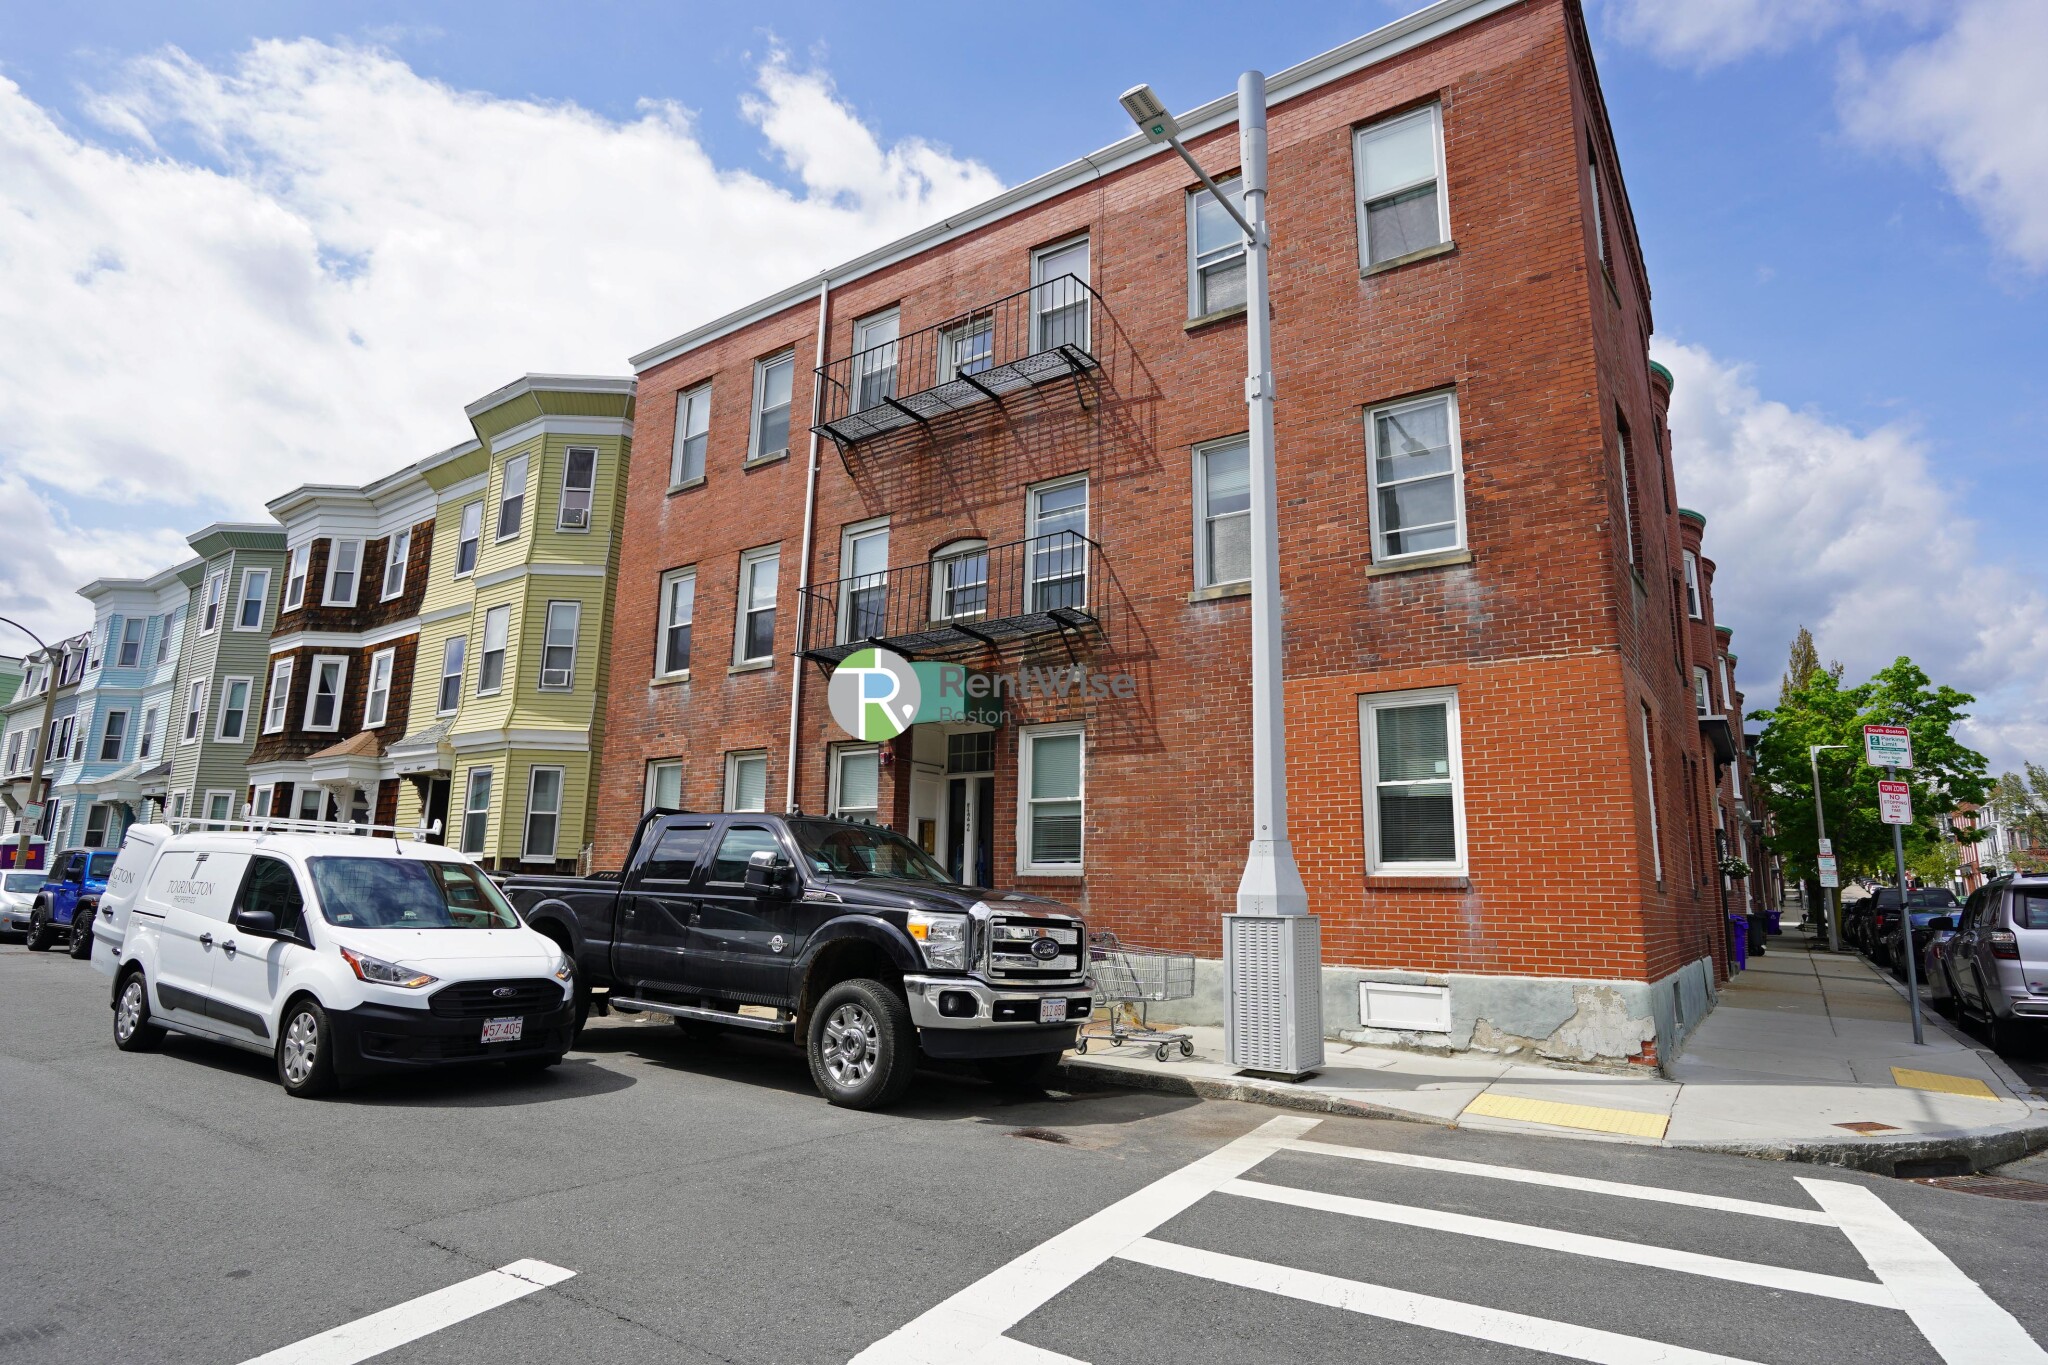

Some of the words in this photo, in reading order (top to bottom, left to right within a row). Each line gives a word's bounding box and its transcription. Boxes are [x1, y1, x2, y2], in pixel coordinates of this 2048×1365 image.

[1871, 735, 1878, 743] 2
[166, 880, 216, 896] TORRINGTON
[1039, 943, 1055, 954] Ford
[483, 1022, 522, 1037] W57-405
